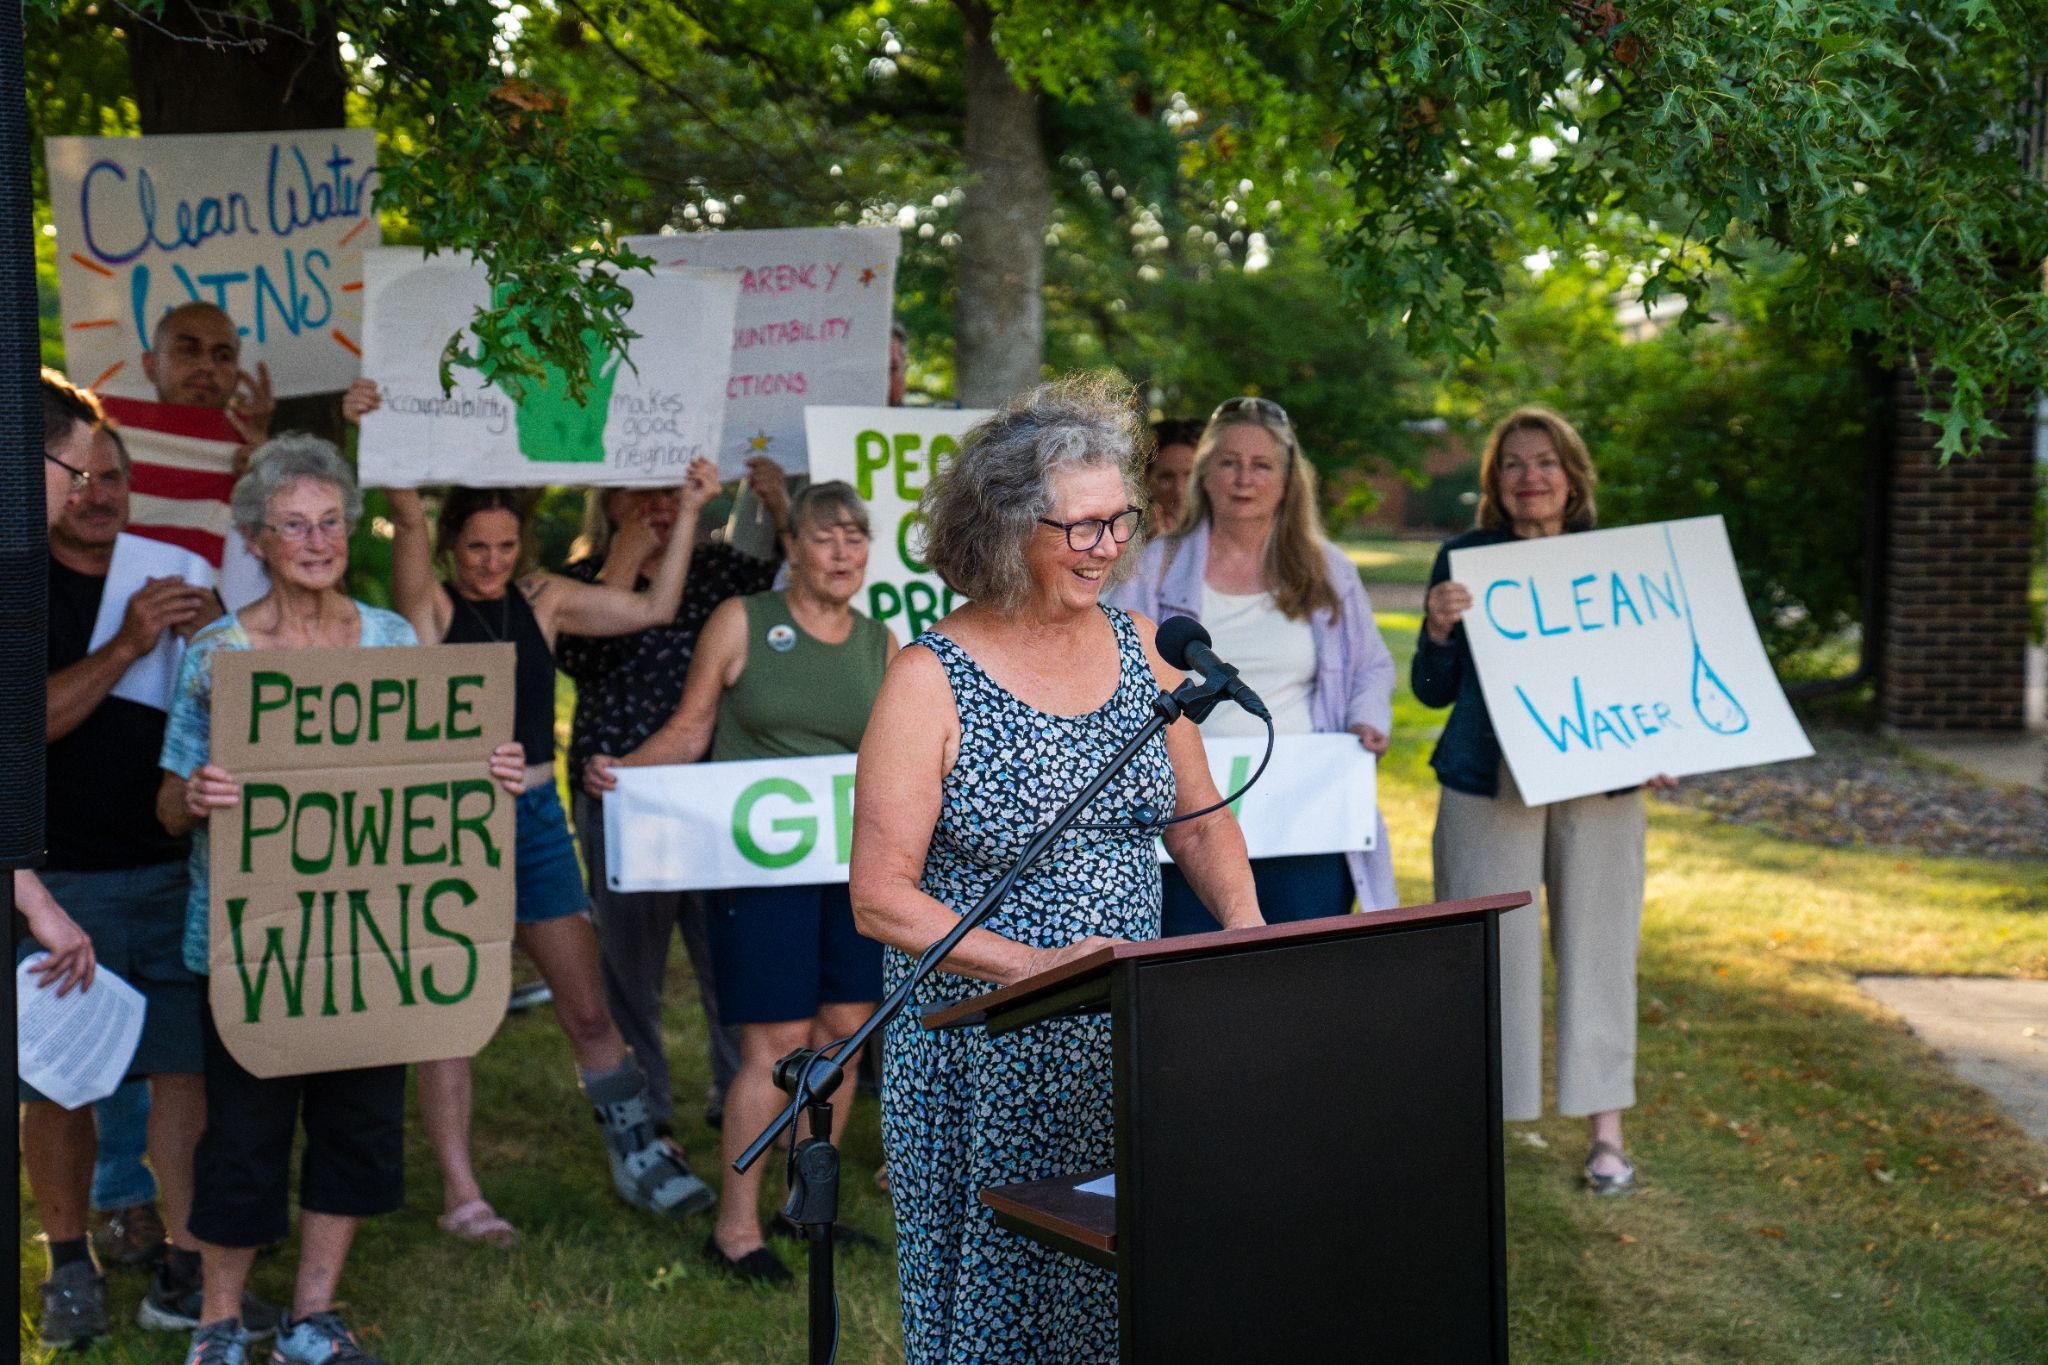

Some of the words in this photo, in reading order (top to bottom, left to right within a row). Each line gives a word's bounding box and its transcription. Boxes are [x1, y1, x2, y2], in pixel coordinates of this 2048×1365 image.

[80, 158, 259, 264] Clean
[736, 261, 845, 296] ARENCY
[1485, 571, 1681, 639] CLEAN
[248, 671, 485, 745] PEOPLE
[1515, 676, 1682, 752] WATER
[239, 779, 500, 875] POWER
[226, 877, 478, 1023] WINS
